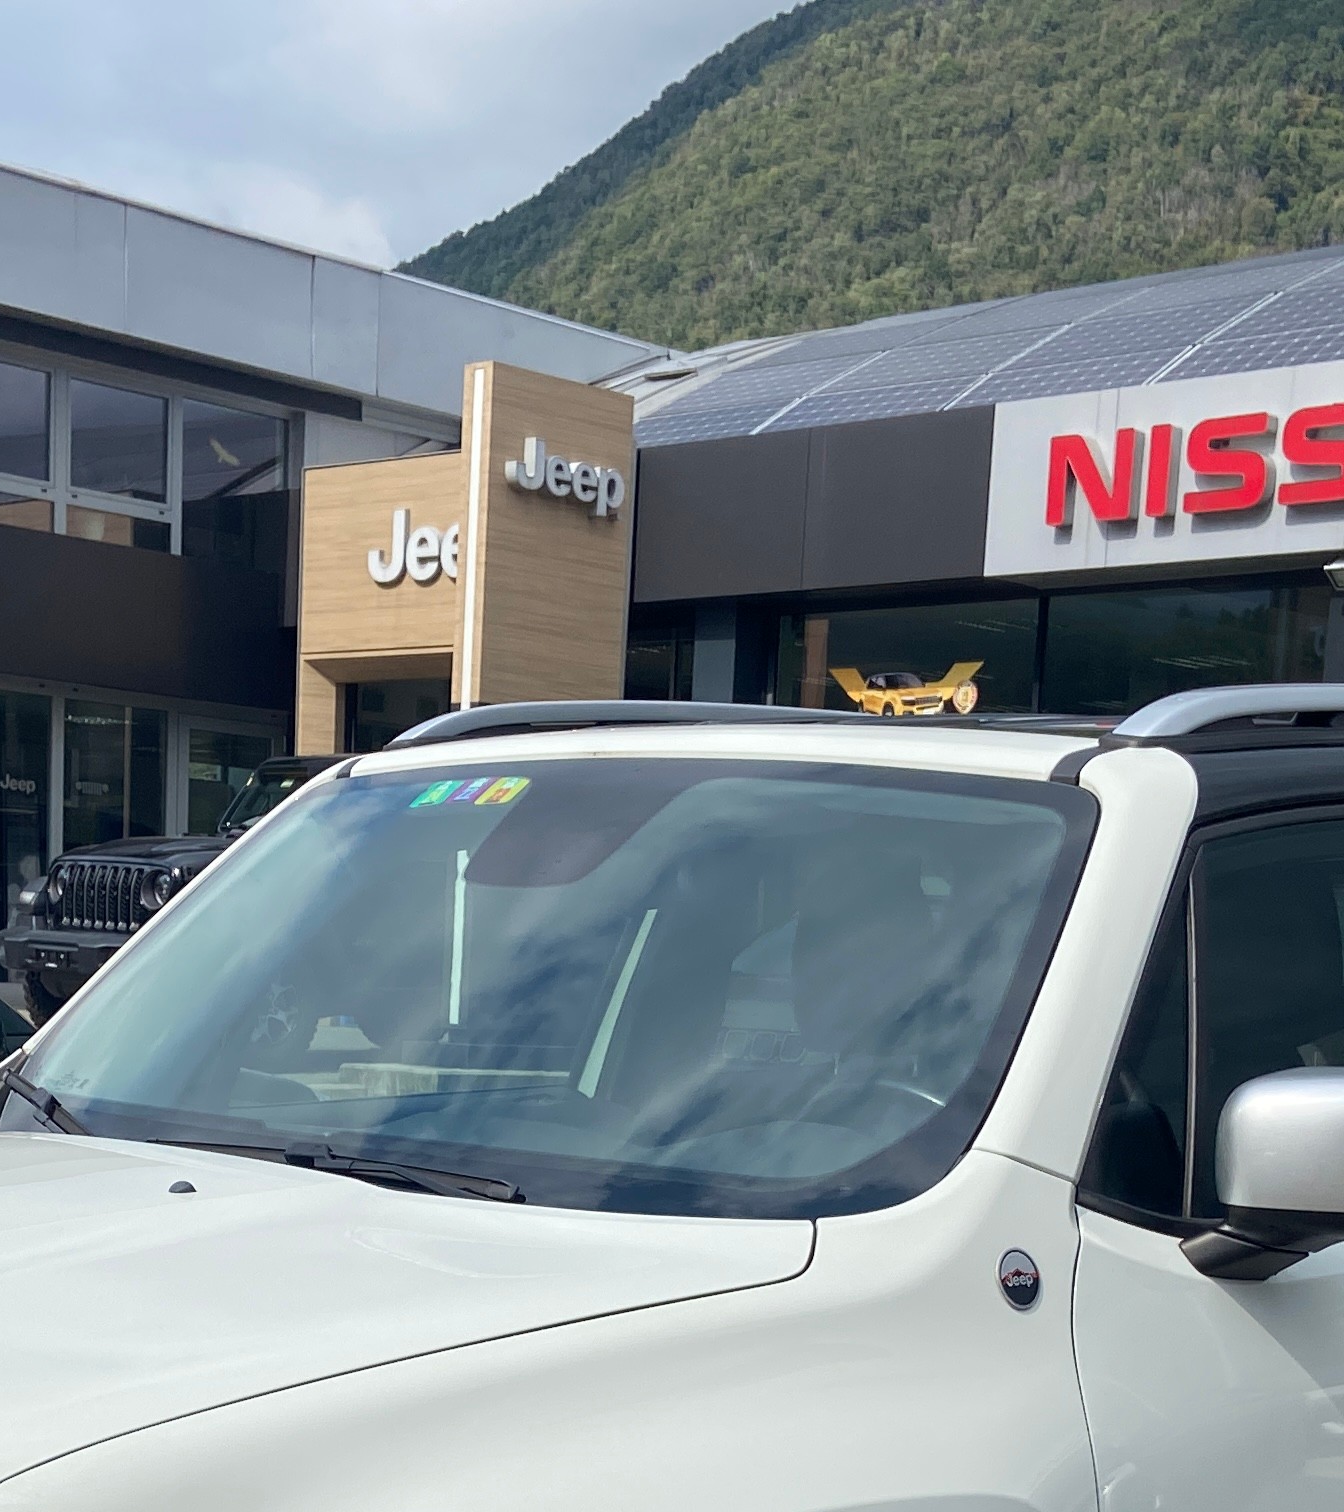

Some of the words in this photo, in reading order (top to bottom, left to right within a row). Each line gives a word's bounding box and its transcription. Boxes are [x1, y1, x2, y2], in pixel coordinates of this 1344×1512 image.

[504, 436, 625, 517] Jeep
[0, 773, 36, 795] Jeep
[1006, 1272, 1034, 1288] Jeep
